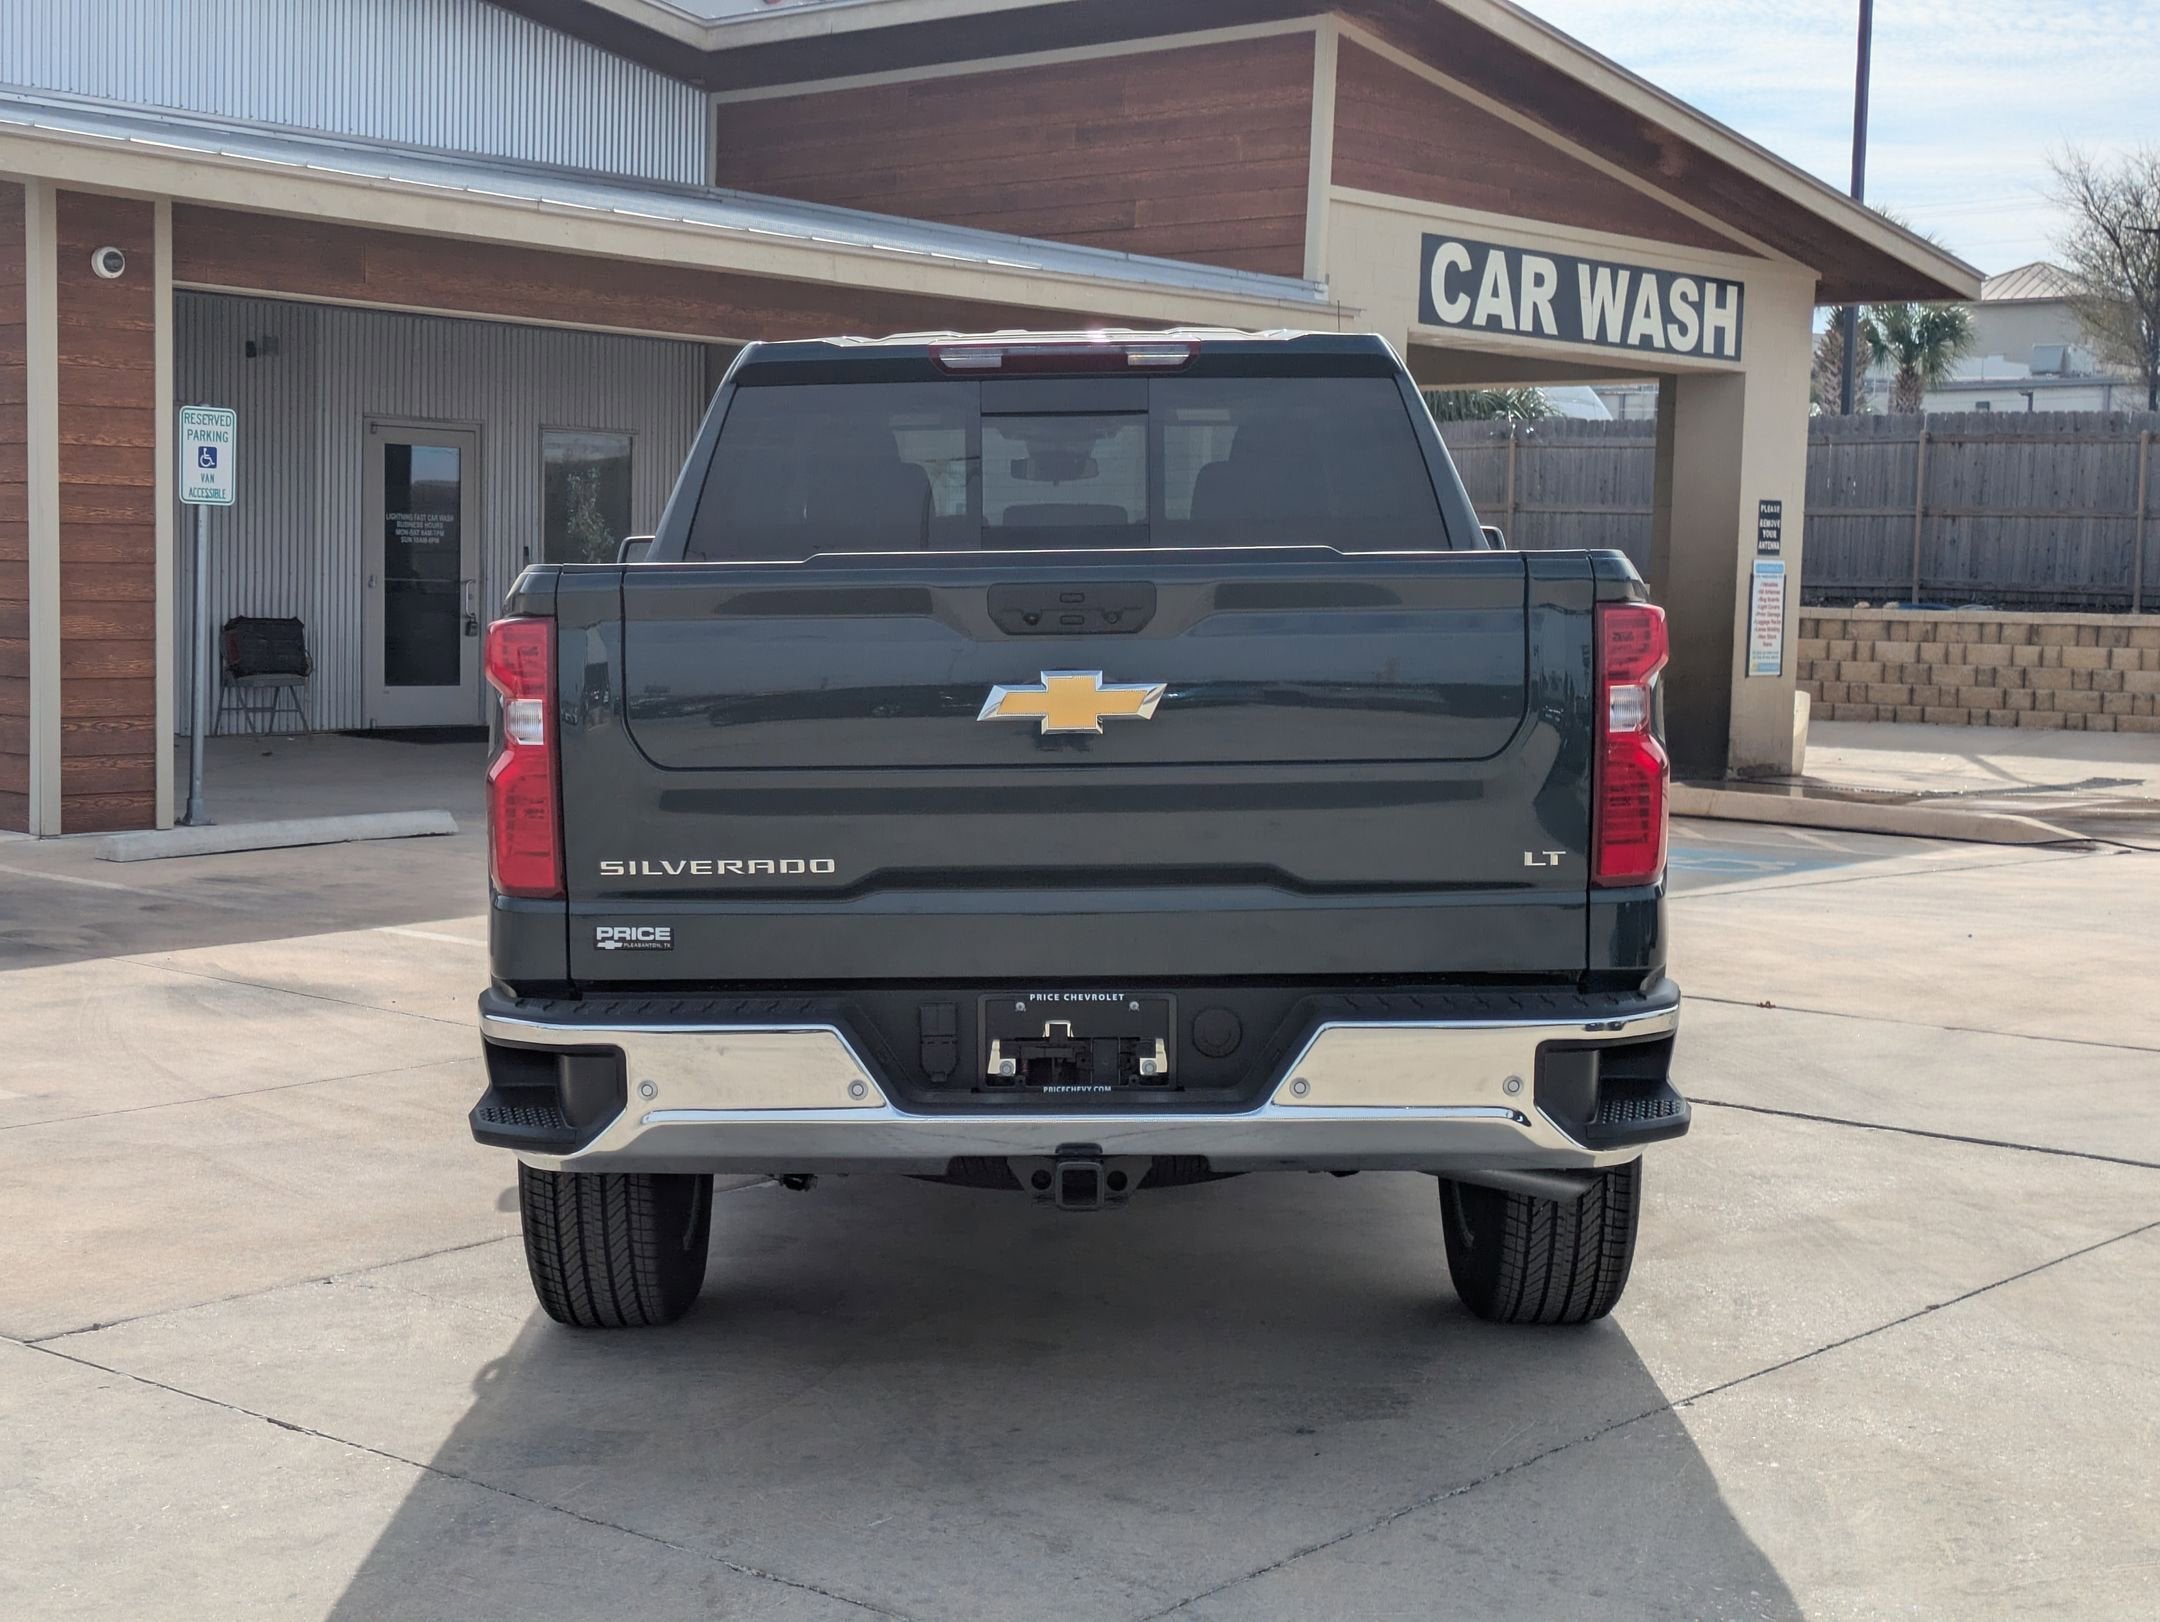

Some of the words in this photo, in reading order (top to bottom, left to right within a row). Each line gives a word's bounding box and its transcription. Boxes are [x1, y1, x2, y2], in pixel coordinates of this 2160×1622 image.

[1430, 241, 1559, 335] CAR
[1577, 263, 1738, 357] WASH
[184, 412, 231, 427] RESERVED
[187, 429, 229, 443] PARKING
[200, 473, 214, 483] VAN
[188, 487, 226, 499] ACCESSIBLE
[1760, 504, 1780, 513] PLEASE
[1759, 519, 1780, 528] REMOVE
[1762, 529, 1777, 539] YOUR
[1758, 540, 1780, 550] ANTENNA
[1524, 850, 1567, 866] LT
[600, 859, 835, 875] SILVERADO
[596, 927, 671, 940] PRICE
[1029, 993, 1059, 1001] PRICE
[1063, 993, 1124, 1001] CHEVROLET
